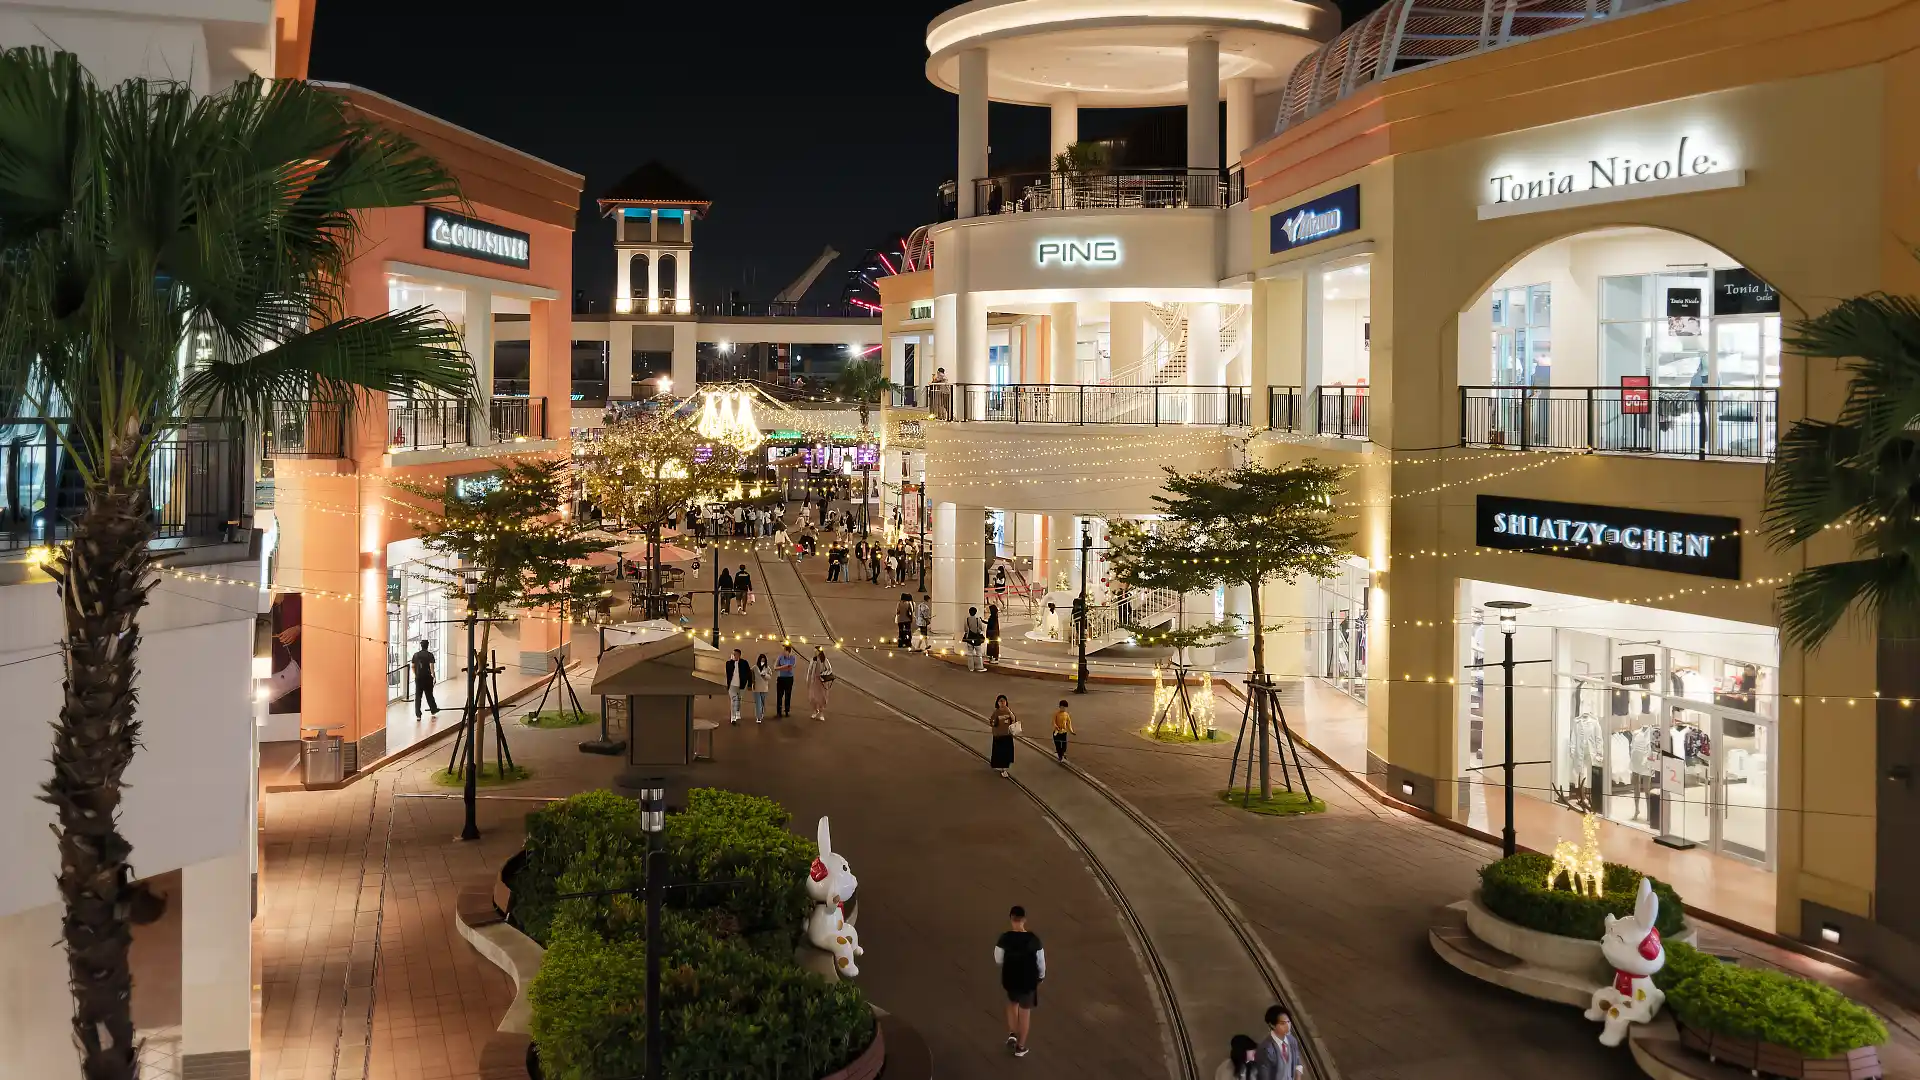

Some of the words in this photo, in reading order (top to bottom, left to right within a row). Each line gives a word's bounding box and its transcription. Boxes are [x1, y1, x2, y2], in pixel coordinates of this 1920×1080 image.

[1489, 171, 1574, 204] Tonia
[1588, 136, 1712, 190] Nicole
[1039, 241, 1117, 263] PING
[1724, 283, 1759, 295] Tonia
[1493, 512, 1608, 545] SHIATZY
[1620, 527, 1711, 558] CHEN
